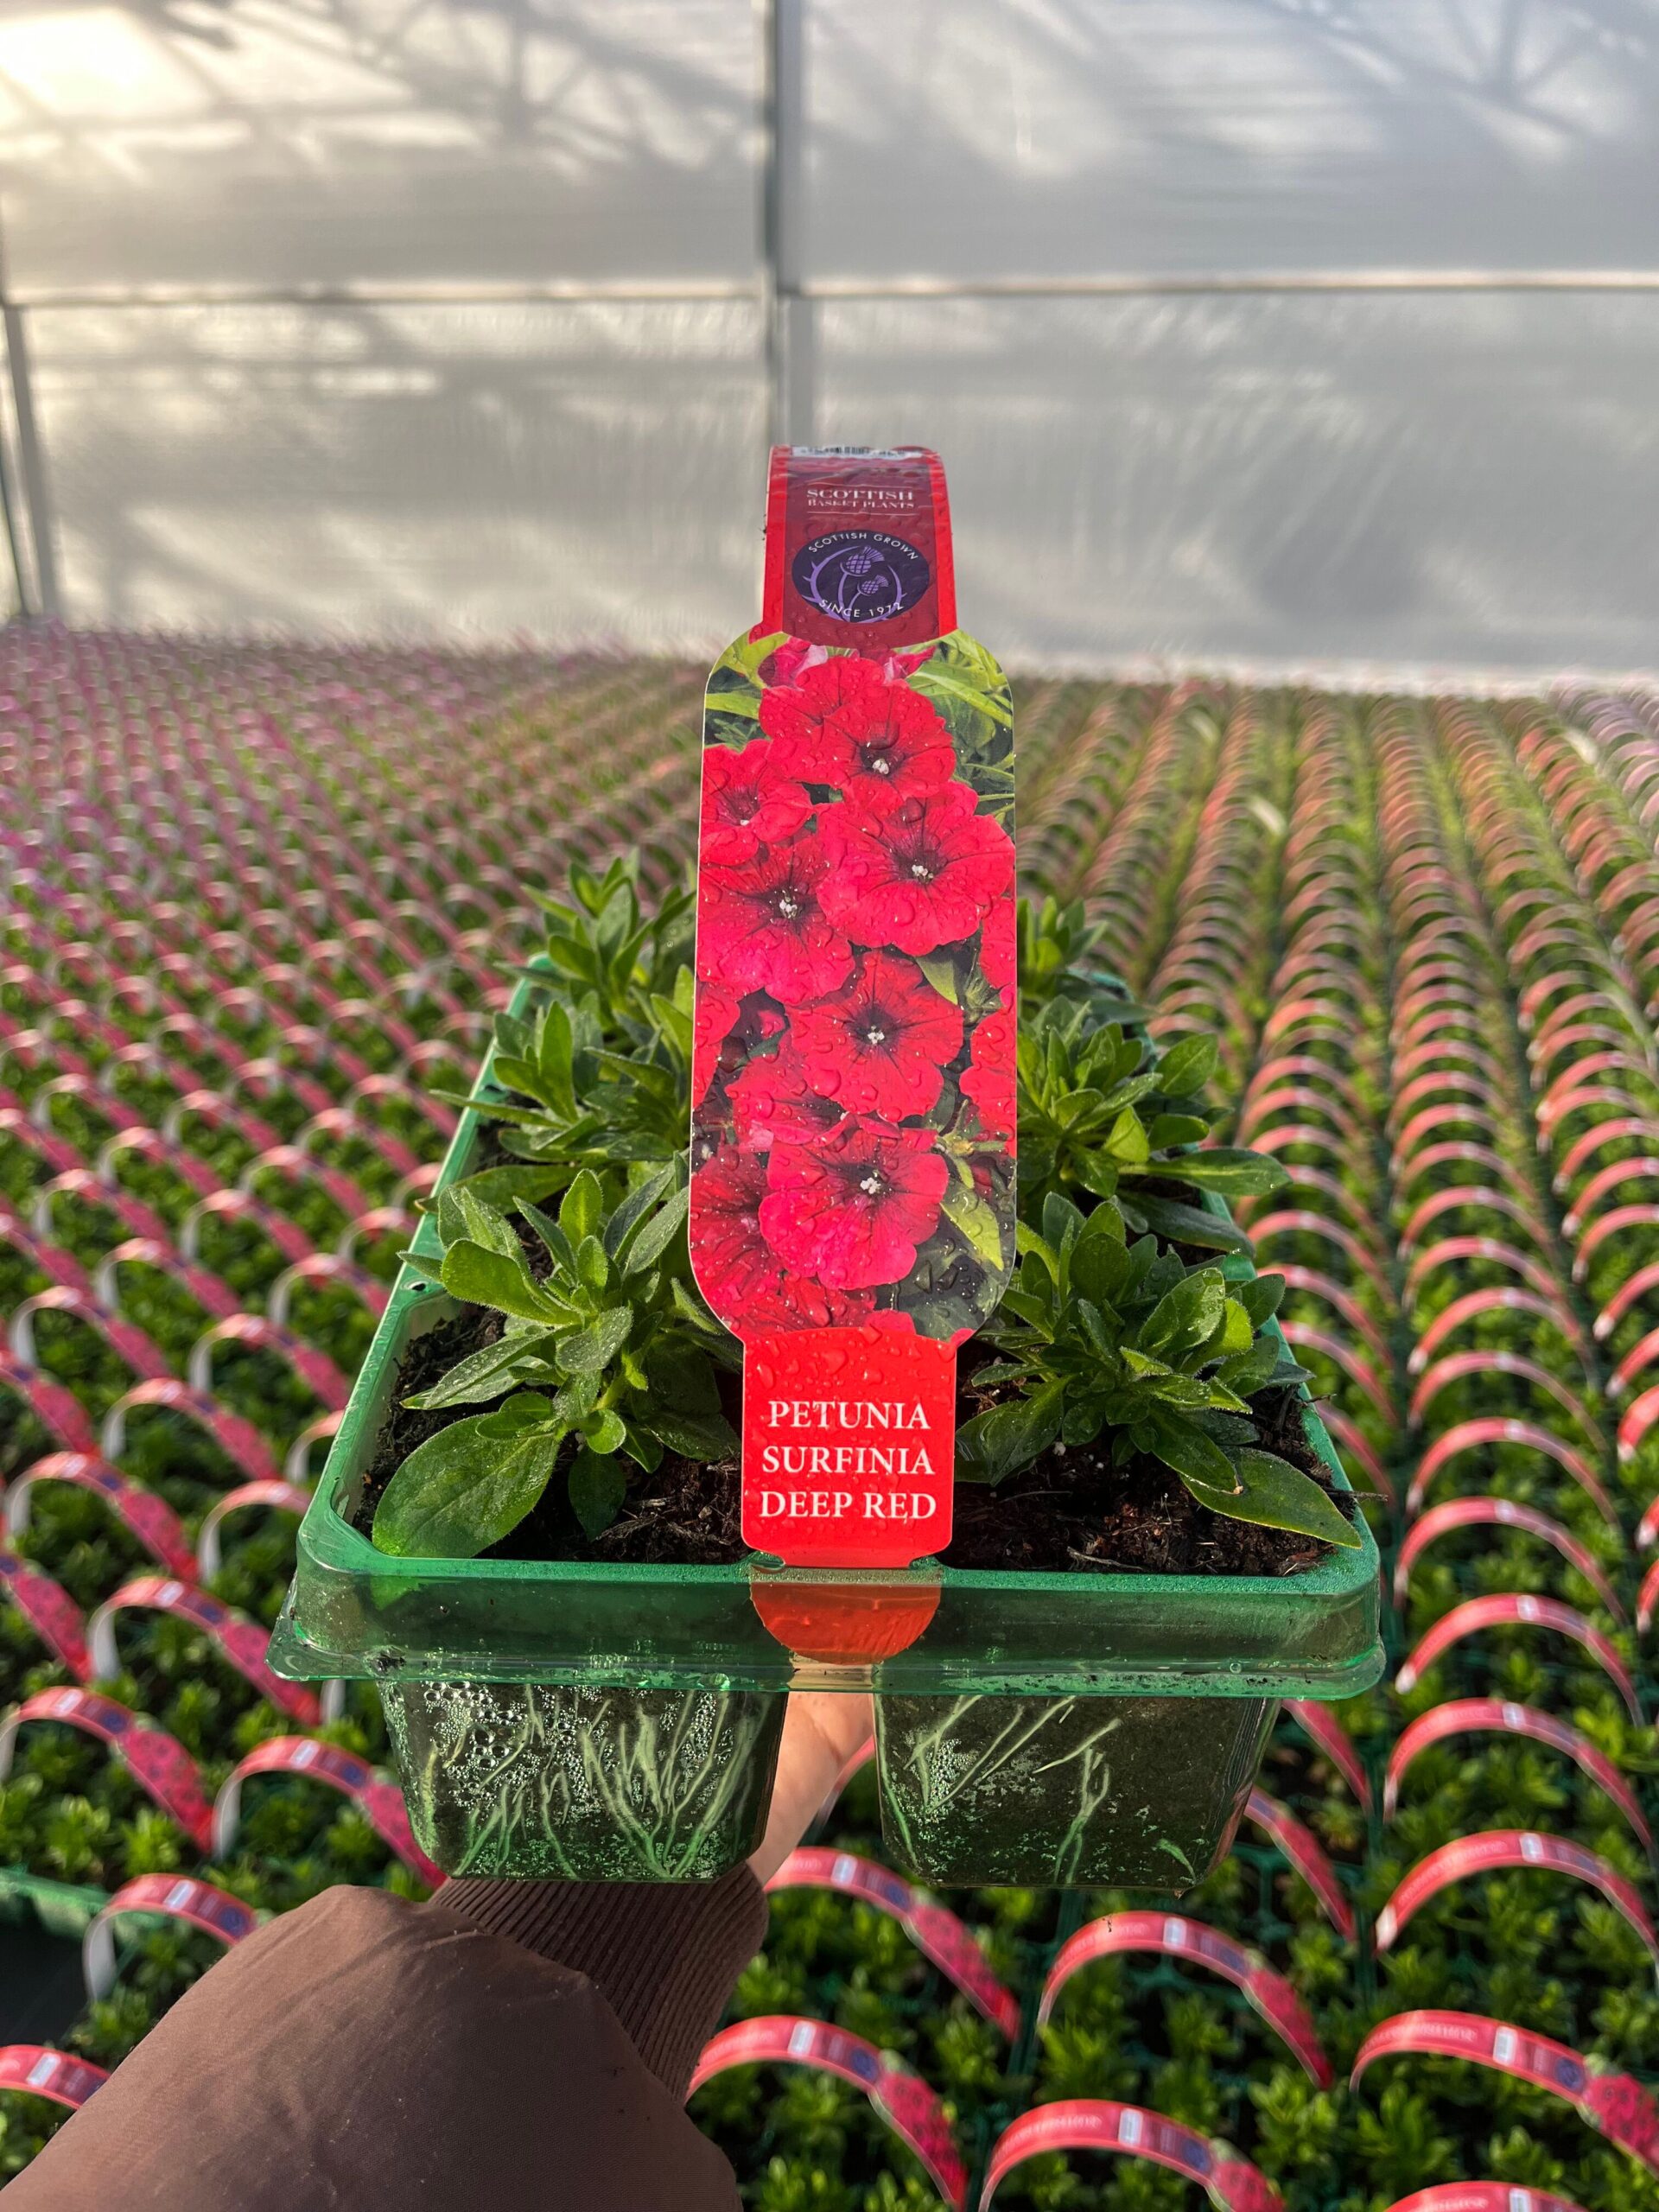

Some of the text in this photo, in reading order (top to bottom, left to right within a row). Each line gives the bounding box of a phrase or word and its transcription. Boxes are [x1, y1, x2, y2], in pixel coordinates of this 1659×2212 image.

[806, 489, 913, 501] SCOTTISH
[807, 499, 915, 509] BASKET PLANTS
[808, 532, 919, 561] SCOTTISH GROWN
[818, 598, 905, 618] SINCE 1972
[767, 1400, 931, 1429] PETUNIA
[761, 1445, 936, 1476] SURFINIA
[759, 1491, 937, 1520] DEEP RED
